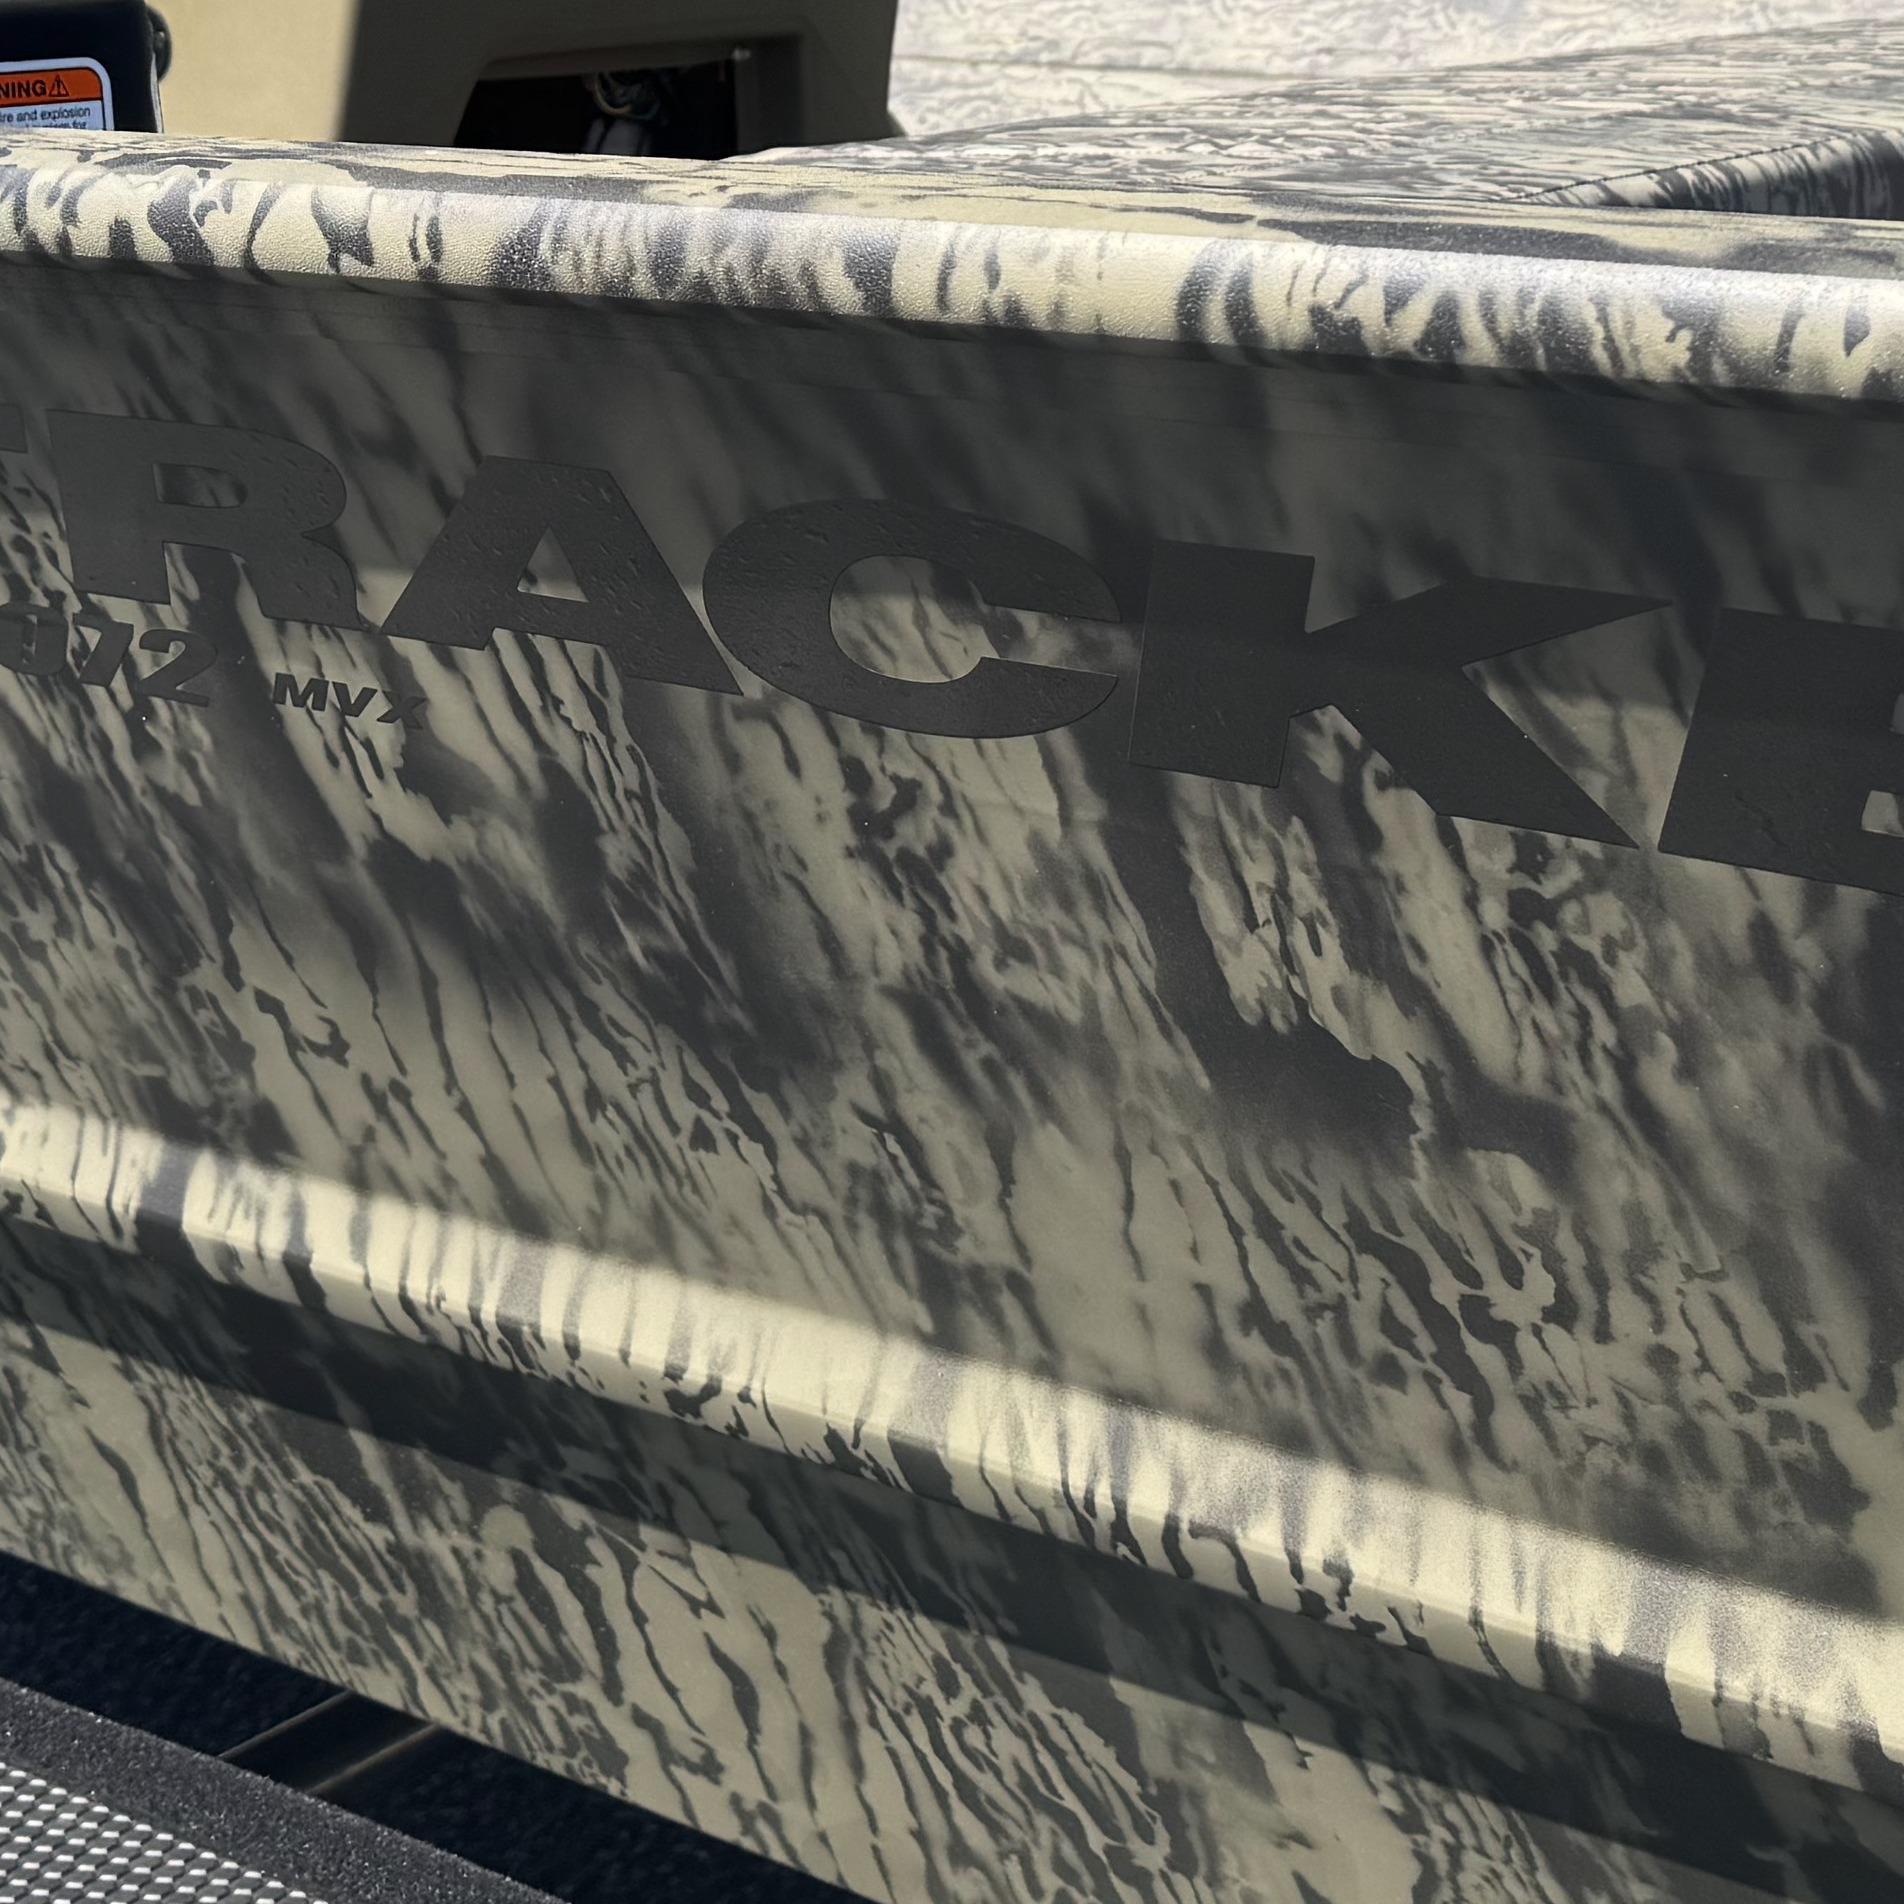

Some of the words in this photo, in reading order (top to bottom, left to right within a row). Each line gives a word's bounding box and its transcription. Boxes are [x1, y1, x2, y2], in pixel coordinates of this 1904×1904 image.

[16, 109, 38, 122] and
[40, 106, 92, 121] explosion
[273, 672, 425, 729] MVX
